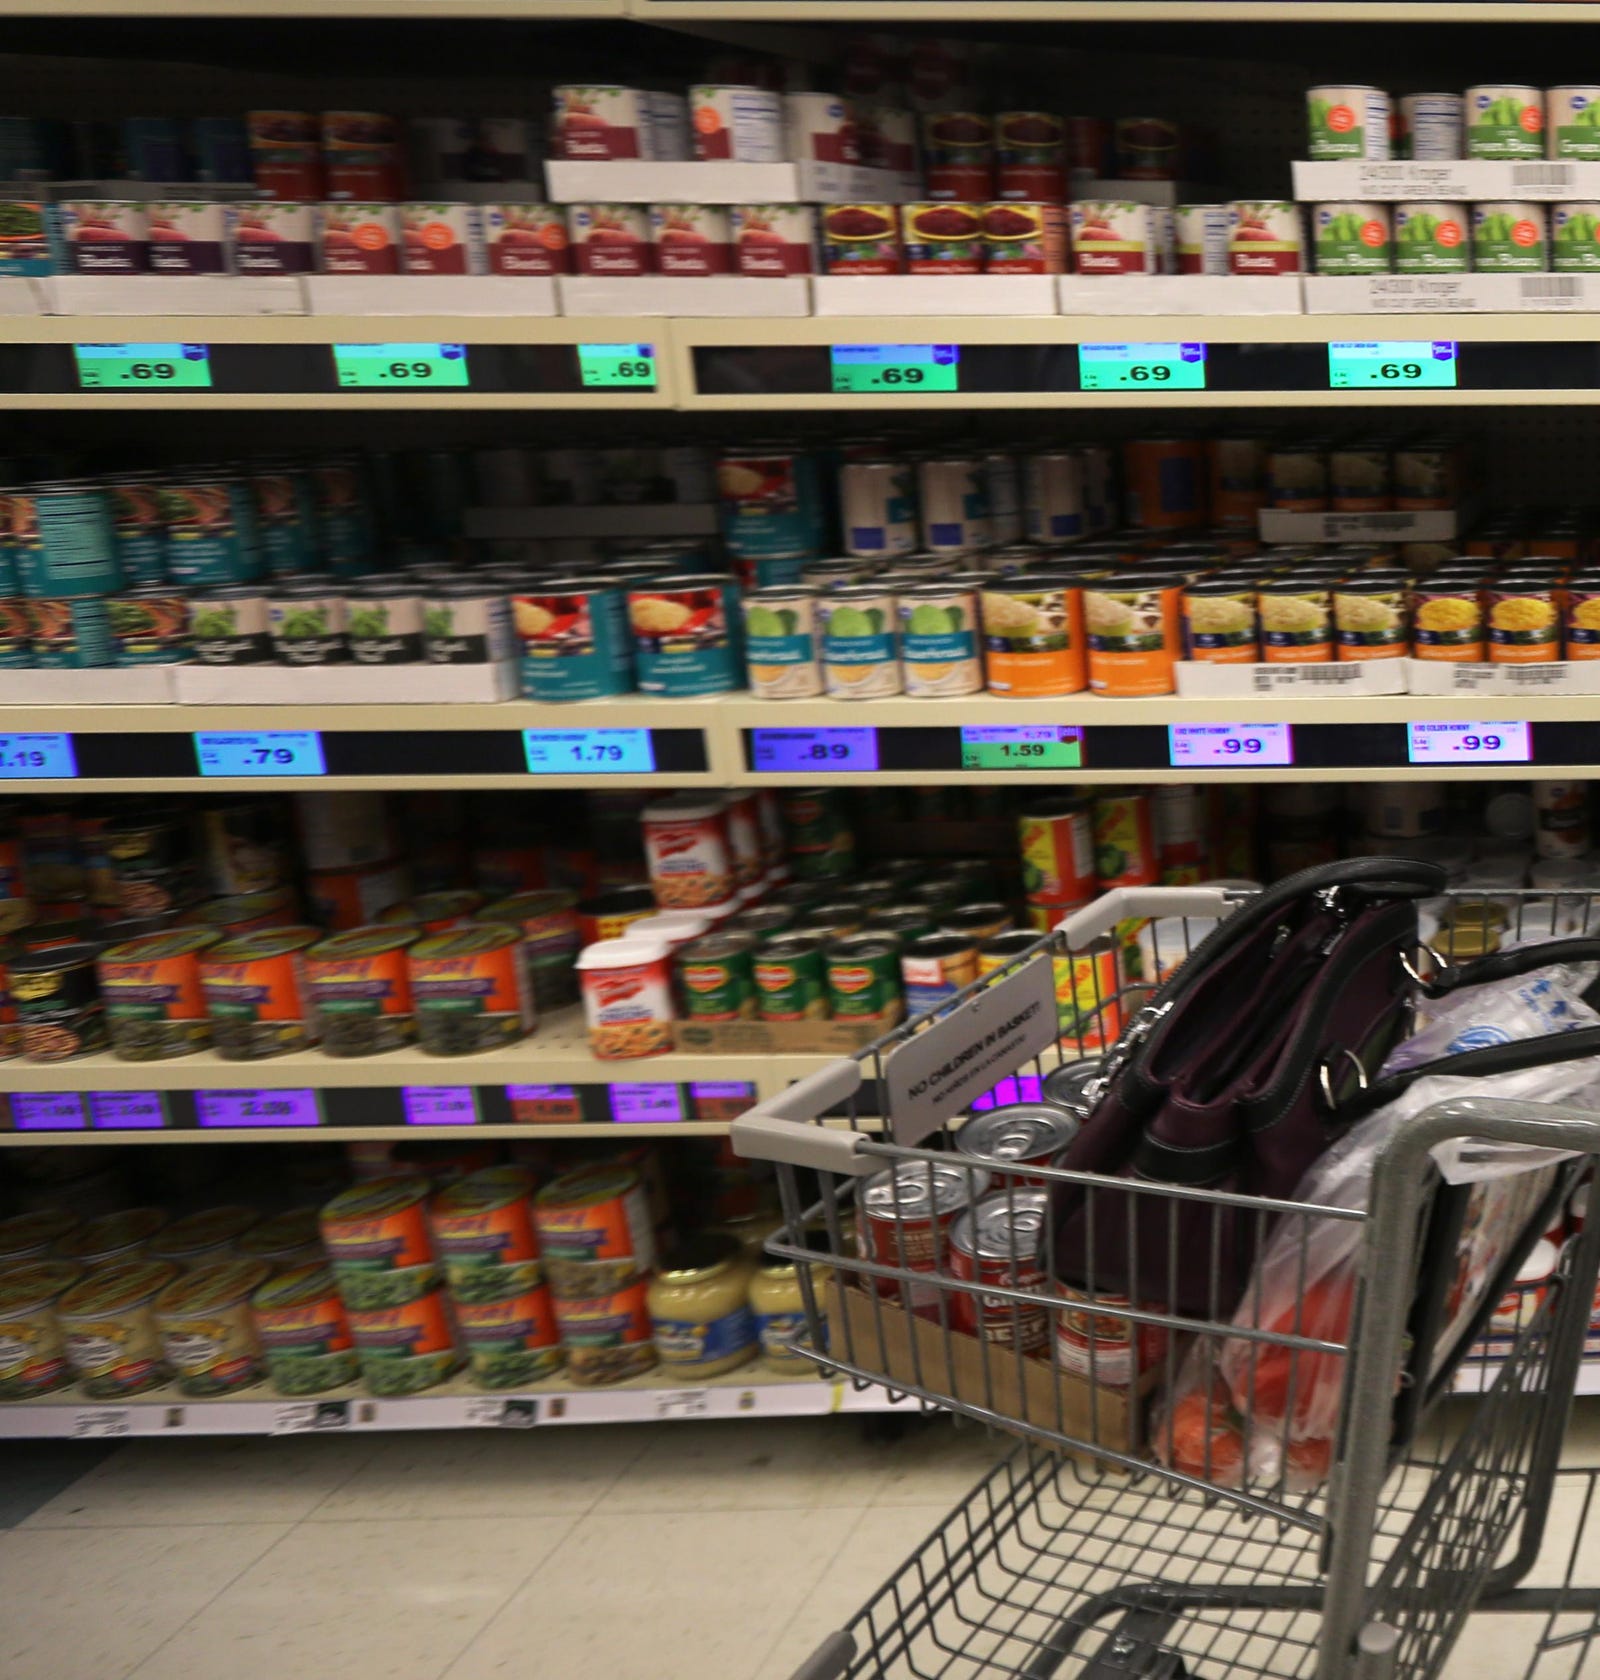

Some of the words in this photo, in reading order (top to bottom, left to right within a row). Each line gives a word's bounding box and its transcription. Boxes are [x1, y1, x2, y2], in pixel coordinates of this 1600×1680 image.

[121, 363, 174, 379] .69
[380, 362, 432, 378] .69
[611, 361, 650, 378] .69
[871, 368, 924, 384] .69
[1120, 365, 1171, 381] .69
[1369, 363, 1423, 379] .69
[999, 744, 1046, 757] 1.59
[1213, 738, 1262, 754] .99
[1452, 735, 1502, 750] .99
[243, 748, 295, 765] .79
[569, 745, 623, 762] 1.79
[798, 744, 850, 760] .89
[908, 1080, 928, 1099] NO
[929, 1041, 985, 1086] CHILDREN
[985, 1032, 998, 1047] IN
